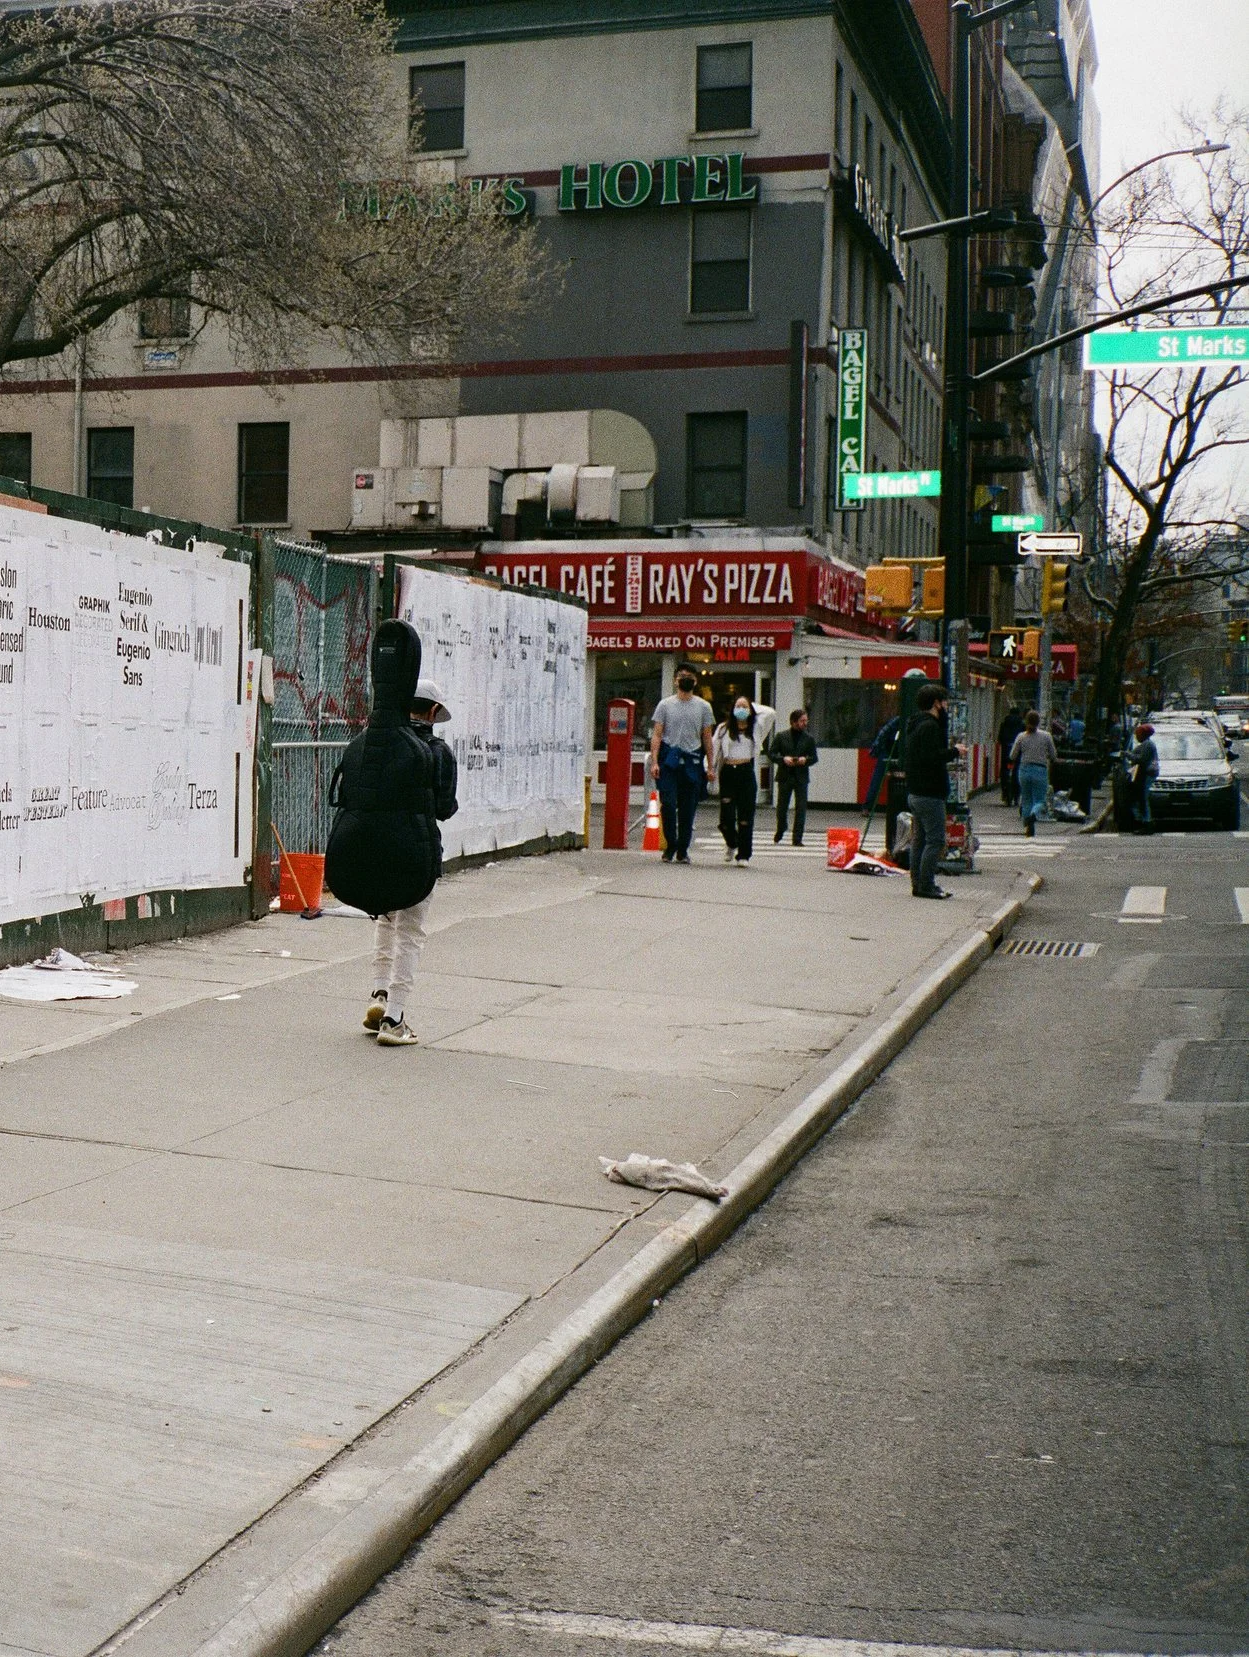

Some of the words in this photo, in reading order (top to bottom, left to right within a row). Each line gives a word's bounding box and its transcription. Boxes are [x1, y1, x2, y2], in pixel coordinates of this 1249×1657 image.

[558, 152, 757, 211] HOTEL
[1158, 336, 1180, 358] St
[1187, 335, 1246, 356] Marks
[843, 332, 862, 420] BAGEL
[857, 476, 874, 497] St
[877, 474, 919, 495] Marks
[560, 556, 616, 604] CAFÉ
[649, 559, 718, 604] RAY'S
[725, 563, 793, 604] PIZZA
[78, 595, 111, 613] GRAPHIK
[118, 581, 153, 608] Eugenio
[28, 606, 71, 631] Houston
[120, 610, 140, 632] Serif
[141, 614, 149, 633] &
[116, 637, 151, 662] Eugenio
[154, 620, 190, 657] Gingrich
[585, 635, 633, 648] BAGELS
[637, 635, 681, 648] BAKED
[710, 635, 775, 648] PREMISES
[123, 666, 143, 686] Sans
[70, 785, 108, 811] Feature
[187, 783, 218, 810] Terza
